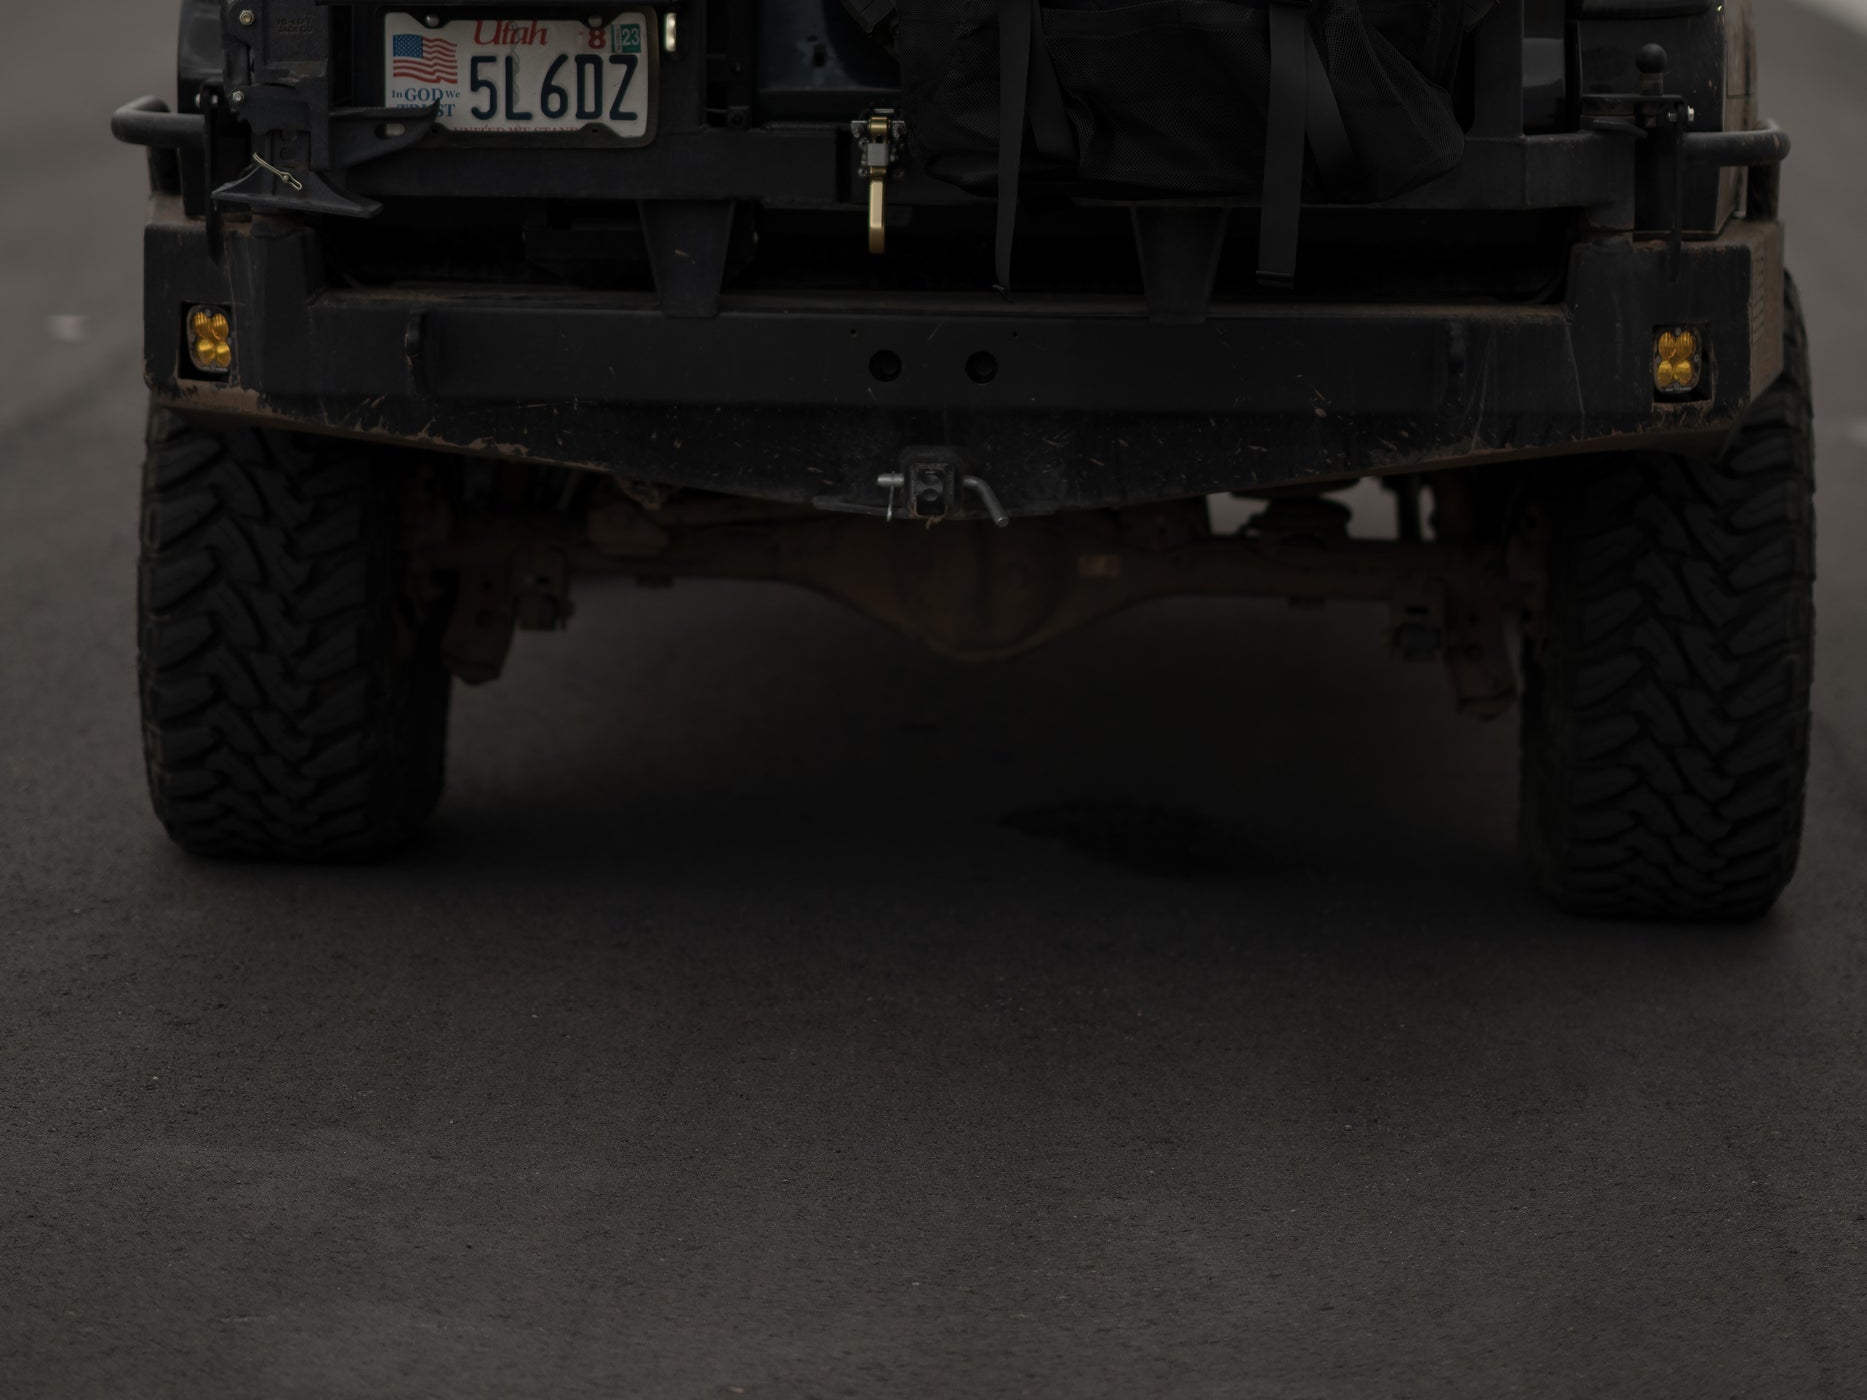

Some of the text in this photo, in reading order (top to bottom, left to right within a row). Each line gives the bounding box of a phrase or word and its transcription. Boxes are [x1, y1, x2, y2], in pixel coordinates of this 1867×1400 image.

[473, 20, 548, 47] Utah
[589, 27, 606, 49] 8
[622, 27, 640, 46] 23
[392, 87, 461, 101] In GOD We
[470, 54, 638, 121] 5L6DZ
